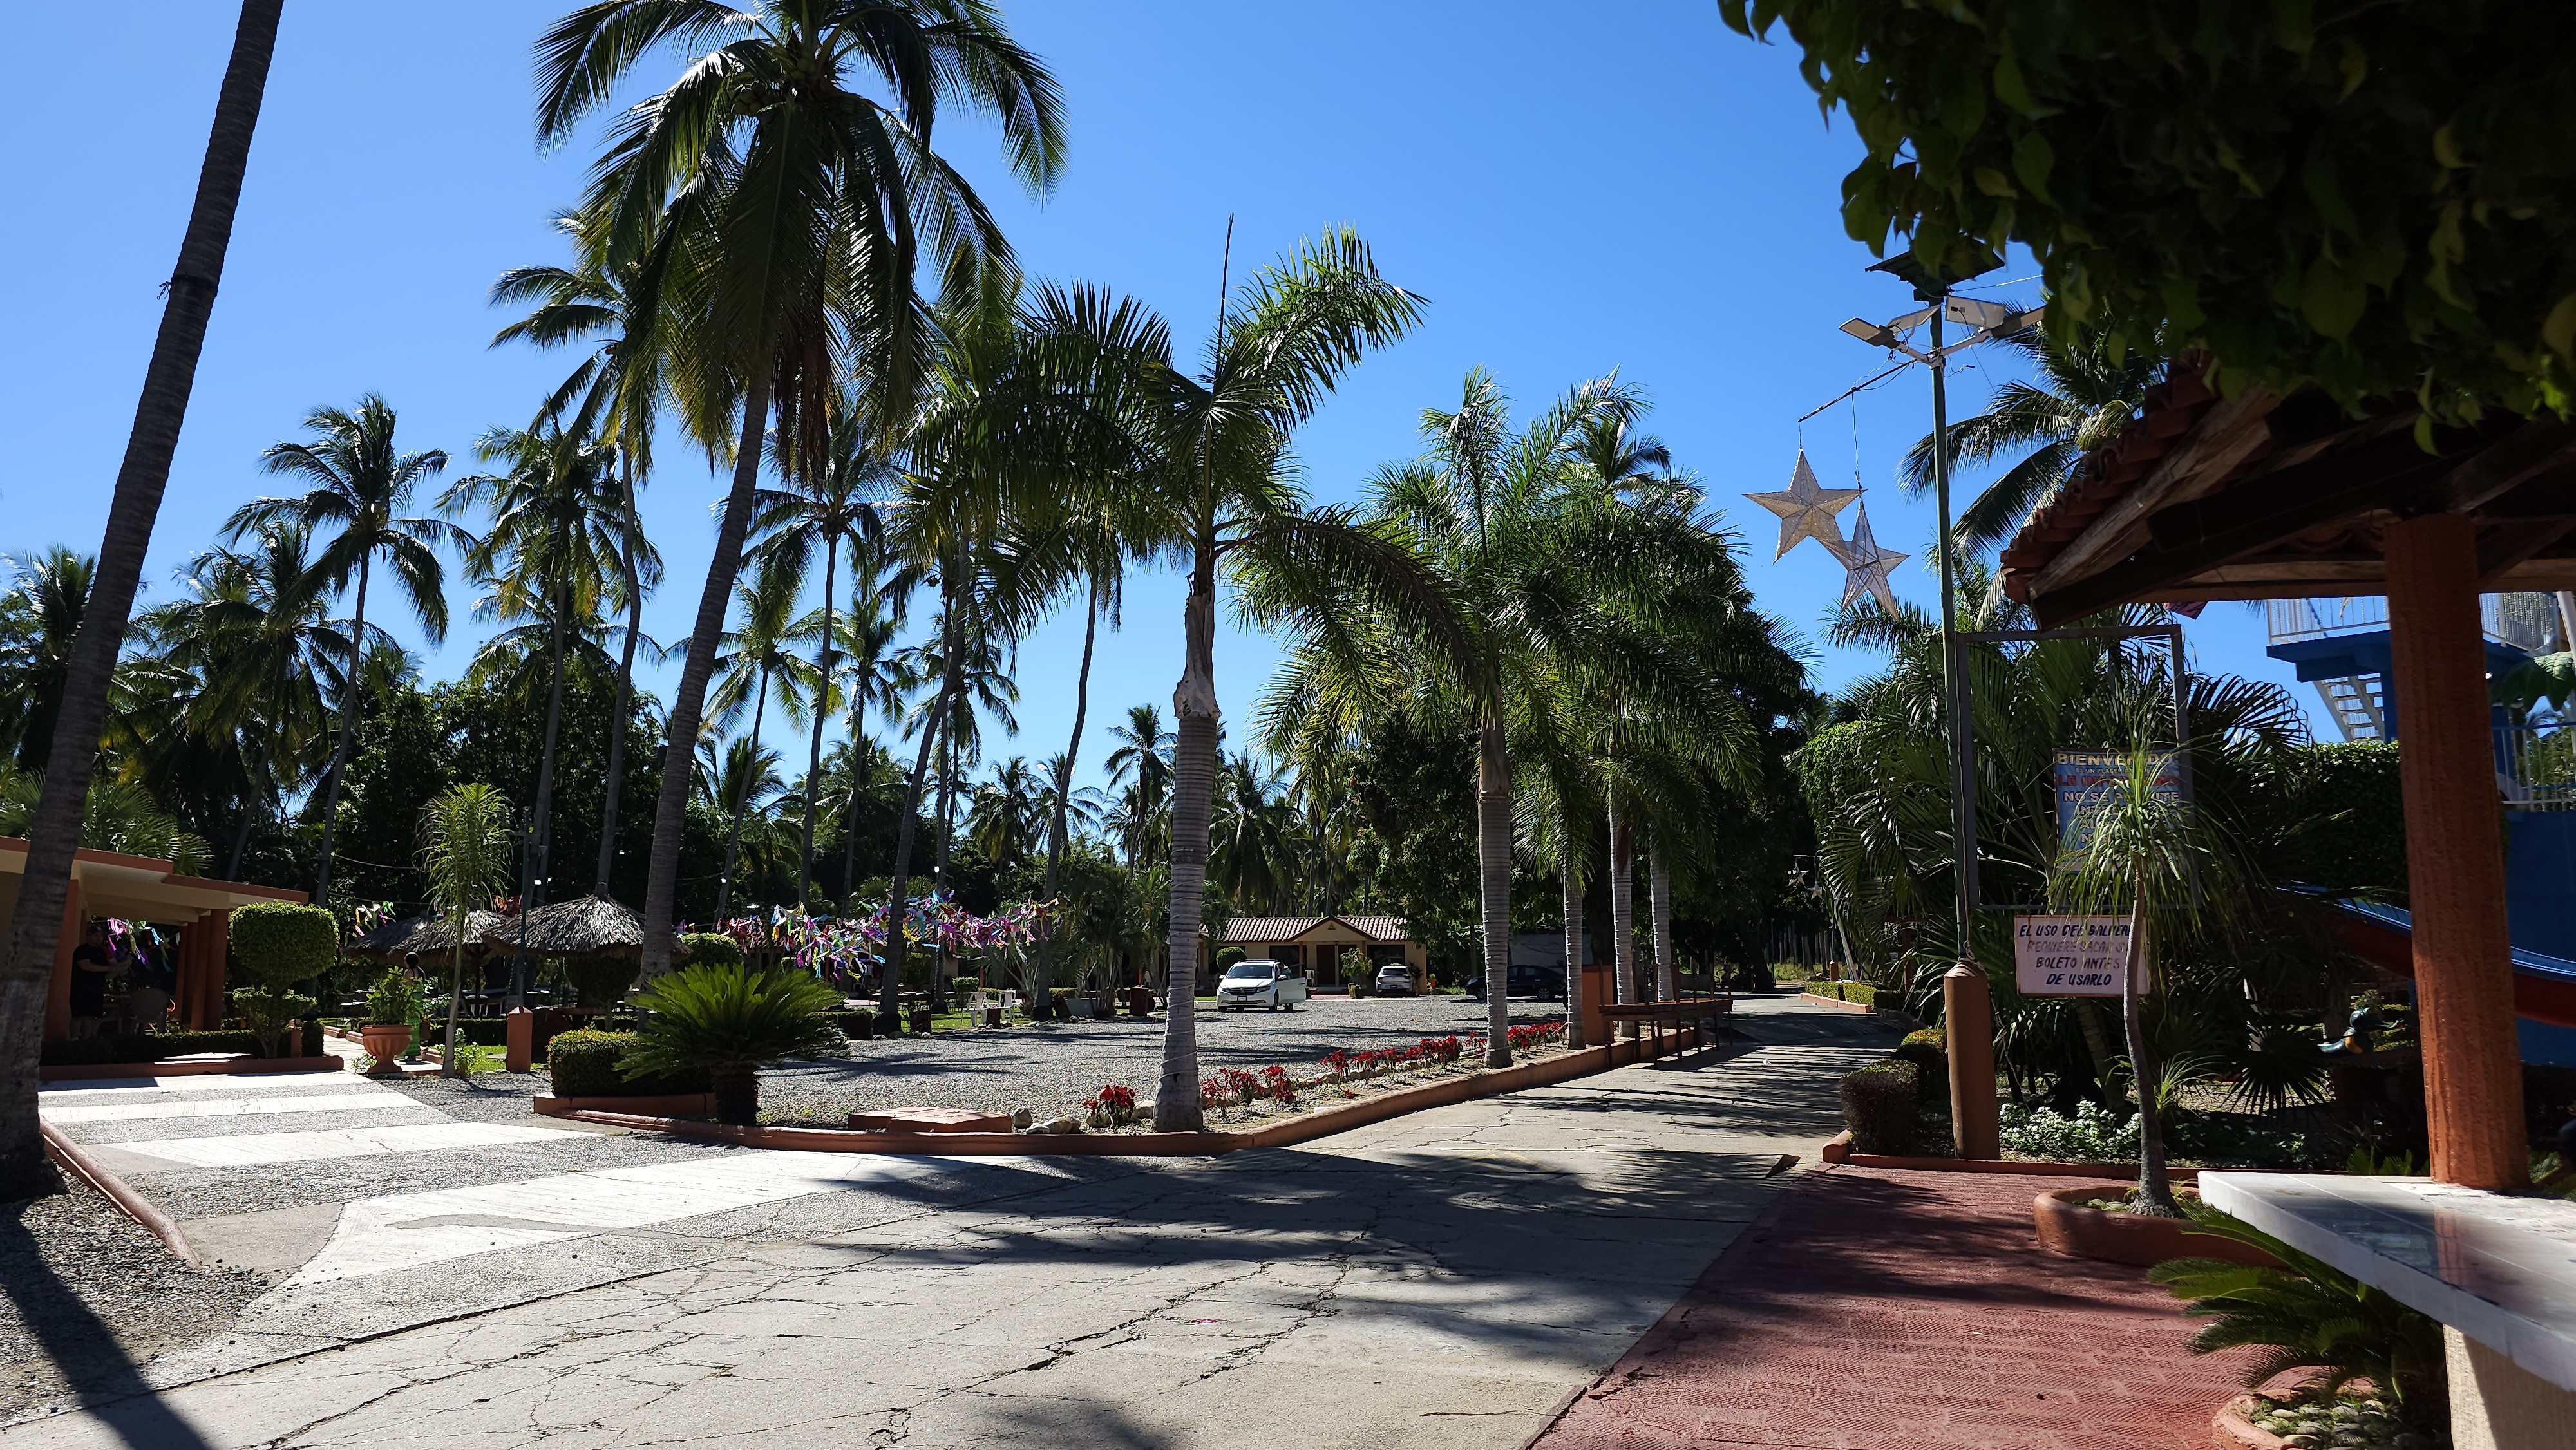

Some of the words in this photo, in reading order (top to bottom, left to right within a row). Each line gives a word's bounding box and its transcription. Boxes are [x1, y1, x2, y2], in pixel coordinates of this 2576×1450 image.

[2058, 775, 2076, 786] LE
[2064, 791, 2085, 802] NO
[2090, 792, 2109, 802] SE
[2019, 925, 2031, 936] EL
[2036, 925, 2058, 936] USO
[2061, 925, 2083, 937] DEL
[2088, 925, 2131, 937] BALNEA
[2027, 941, 2076, 952] REQUIERE
[2036, 957, 2077, 969] BOLETO
[2046, 974, 2065, 985] DE
[2068, 973, 2112, 986] USARLO
